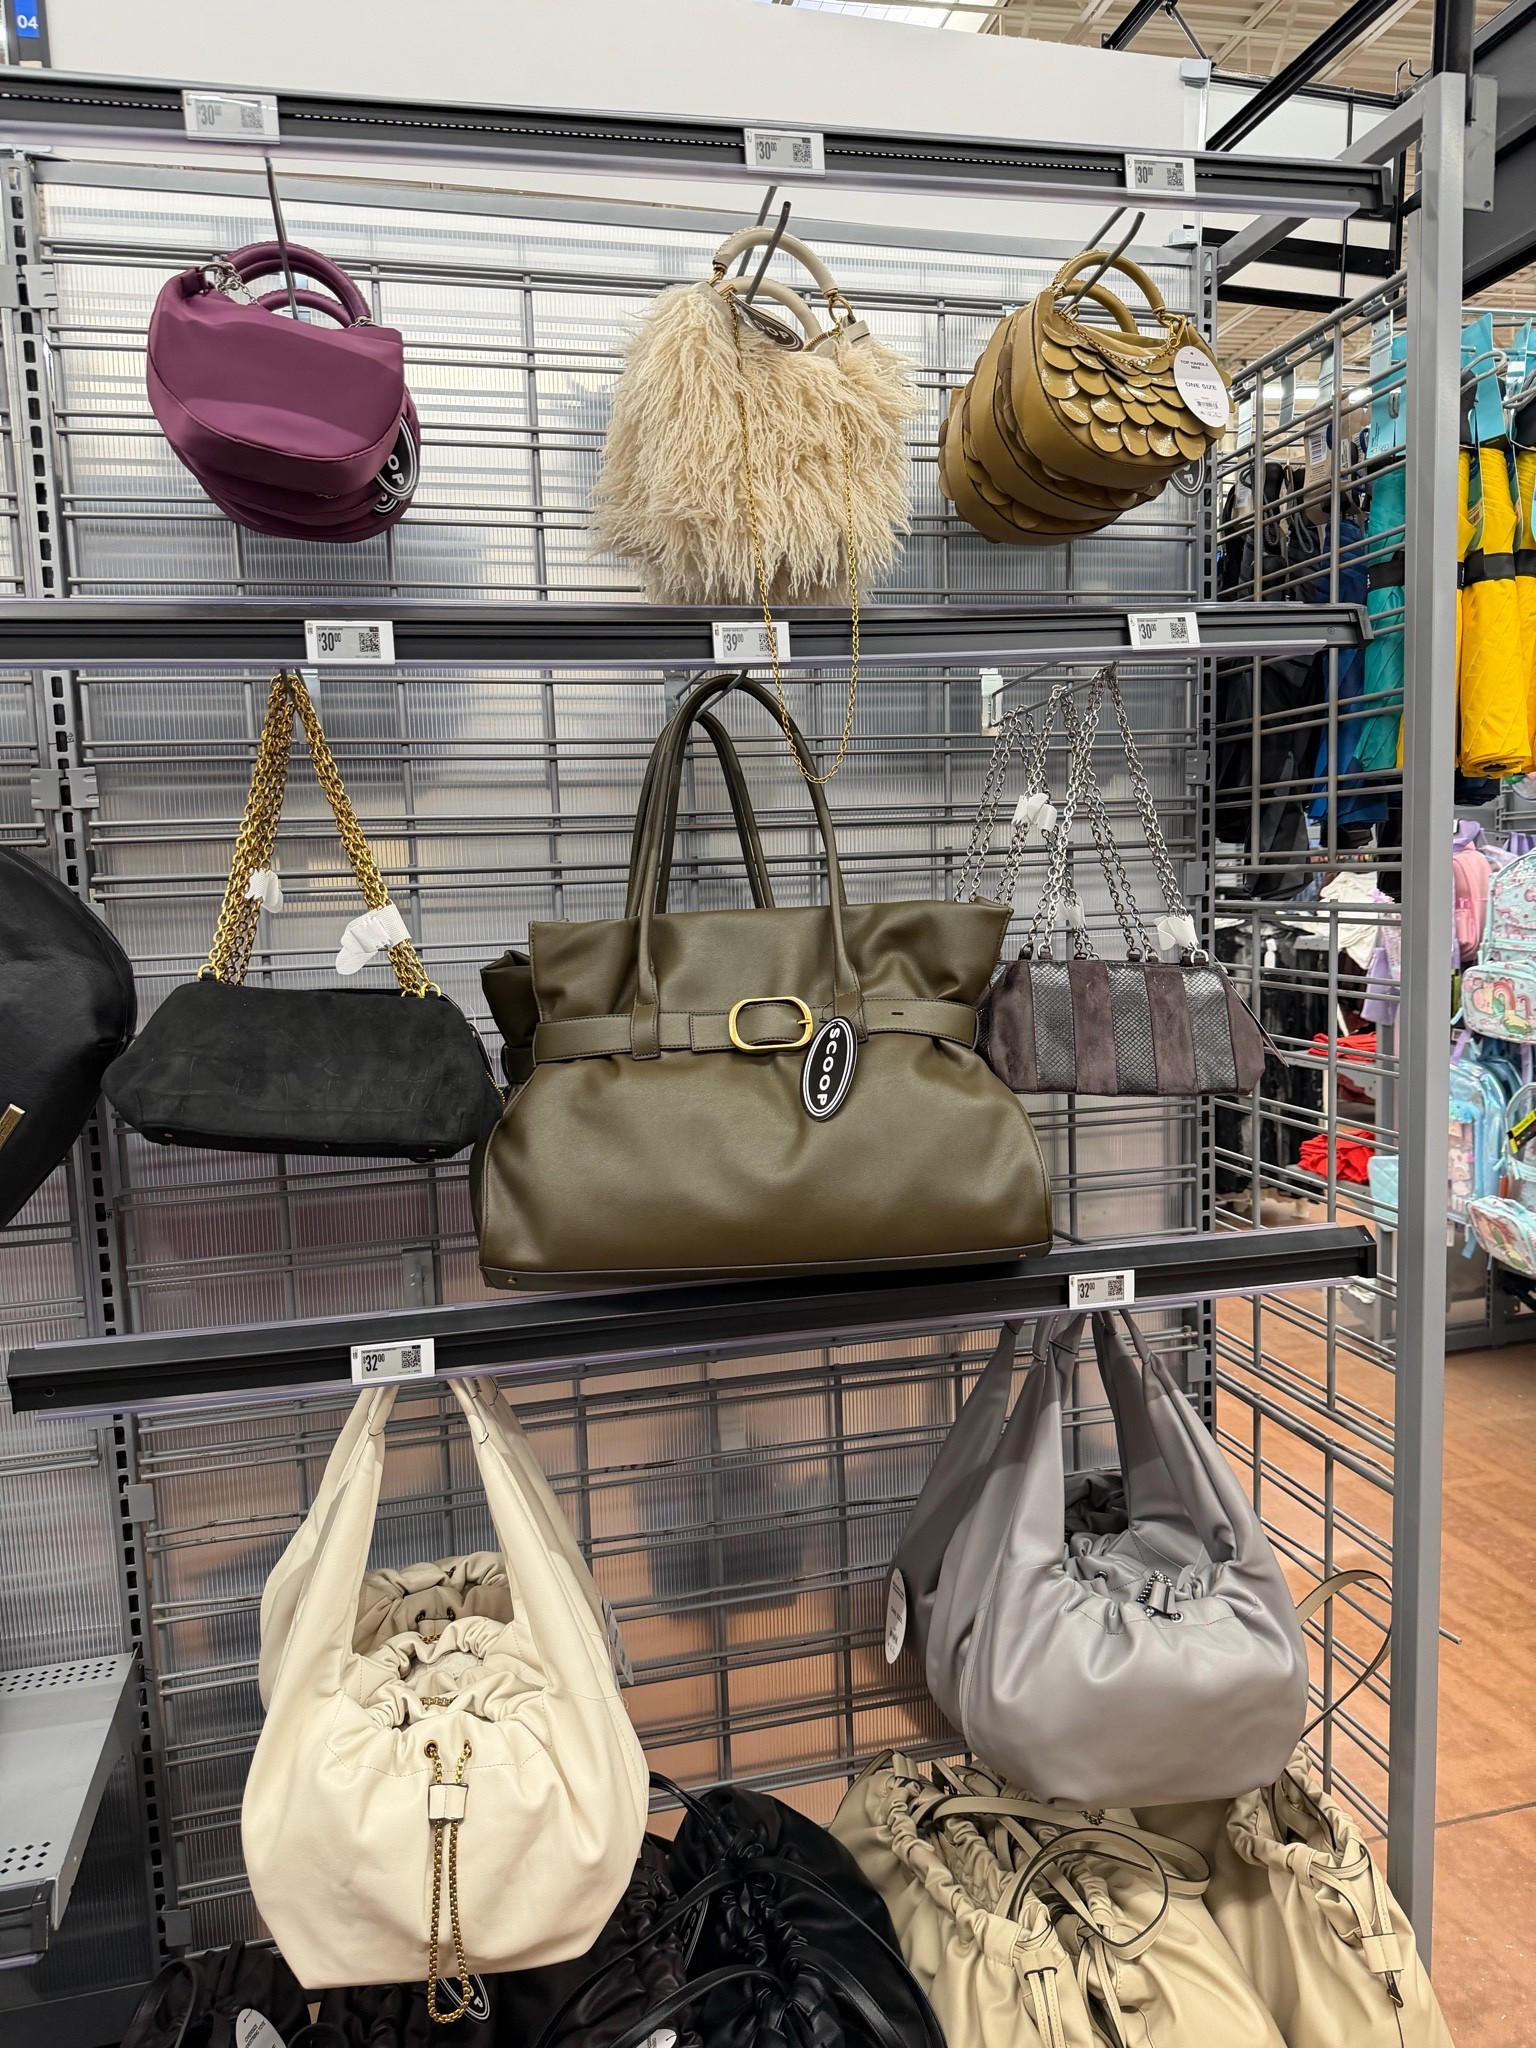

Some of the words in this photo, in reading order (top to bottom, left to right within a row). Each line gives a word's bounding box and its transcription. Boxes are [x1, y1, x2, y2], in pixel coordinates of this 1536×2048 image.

[17, 14, 39, 29] 04
[754, 319, 789, 340] OOP
[1185, 381, 1200, 389] ONE
[1202, 383, 1218, 391] SIZE
[817, 1027, 841, 1106] SCOOP
